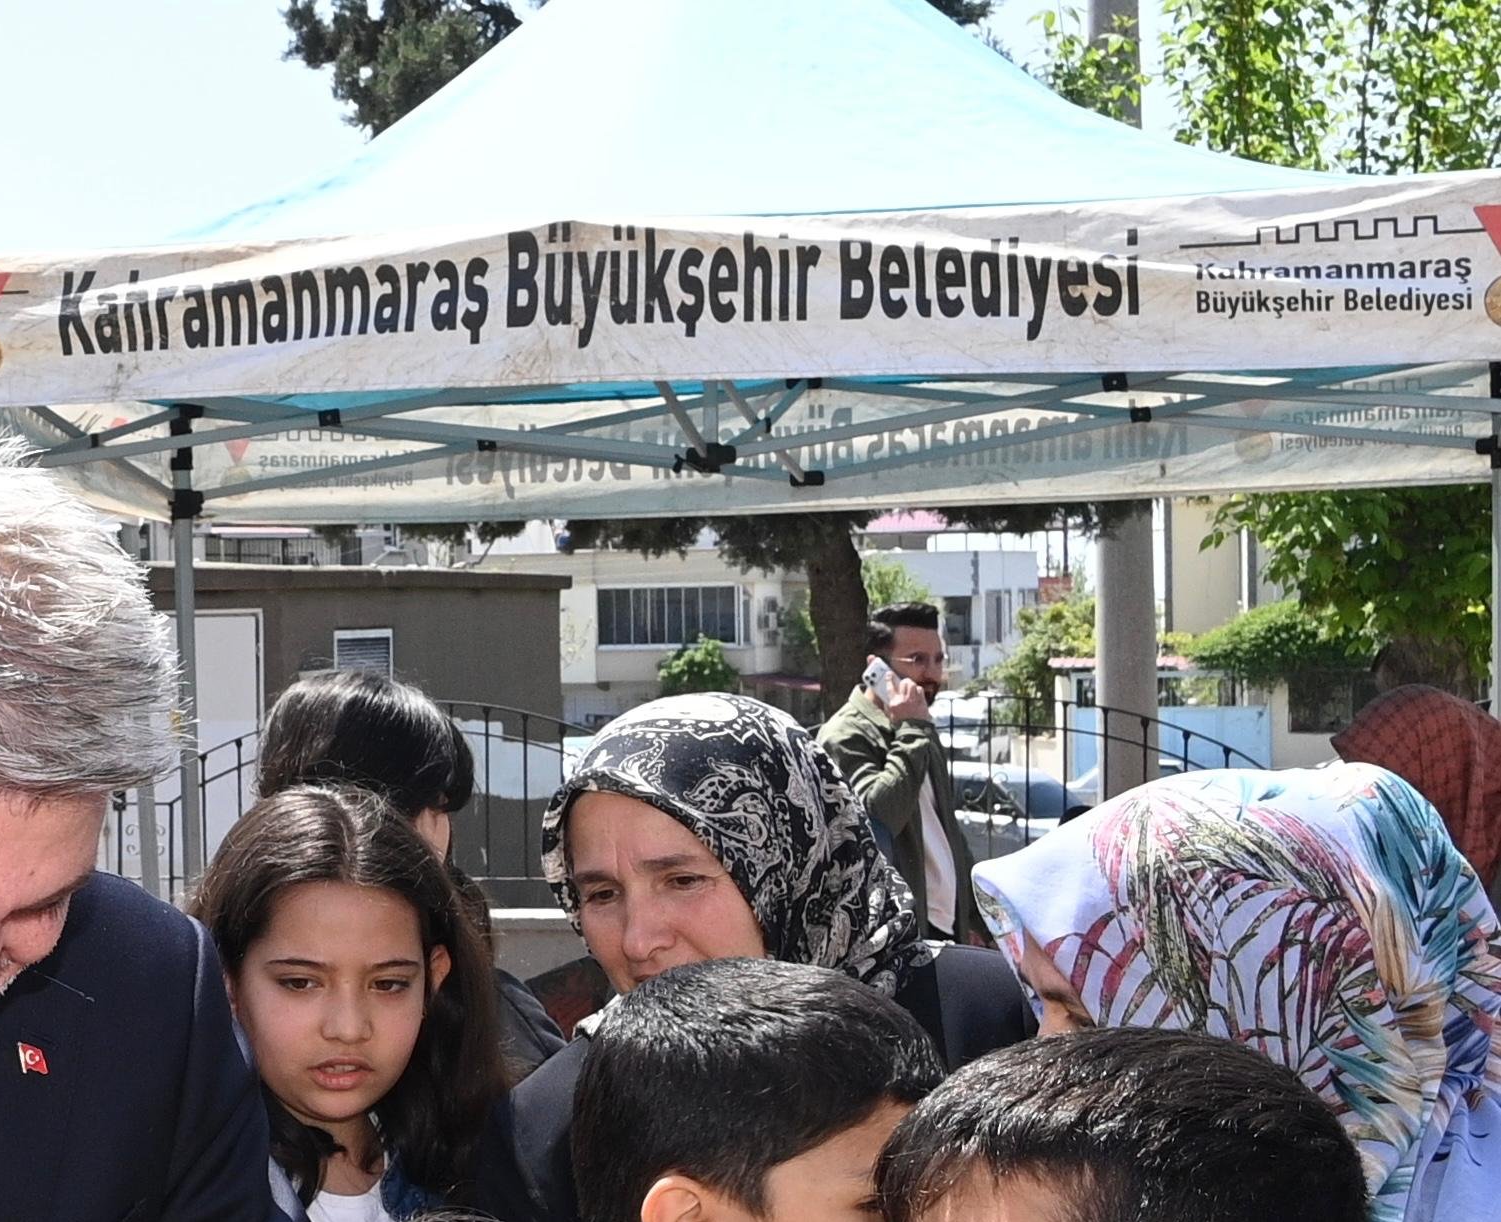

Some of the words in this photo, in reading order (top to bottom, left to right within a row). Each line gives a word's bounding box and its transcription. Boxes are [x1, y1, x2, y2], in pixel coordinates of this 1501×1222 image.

[1195, 257, 1472, 285] Kahramanmaraş
[58, 256, 490, 356] Kahramanmaraş
[506, 220, 822, 349] Büyükşehir
[839, 228, 1140, 341] Belediyesi
[1196, 287, 1335, 319] Büyükşehir
[1343, 286, 1473, 316] Belediyesi
